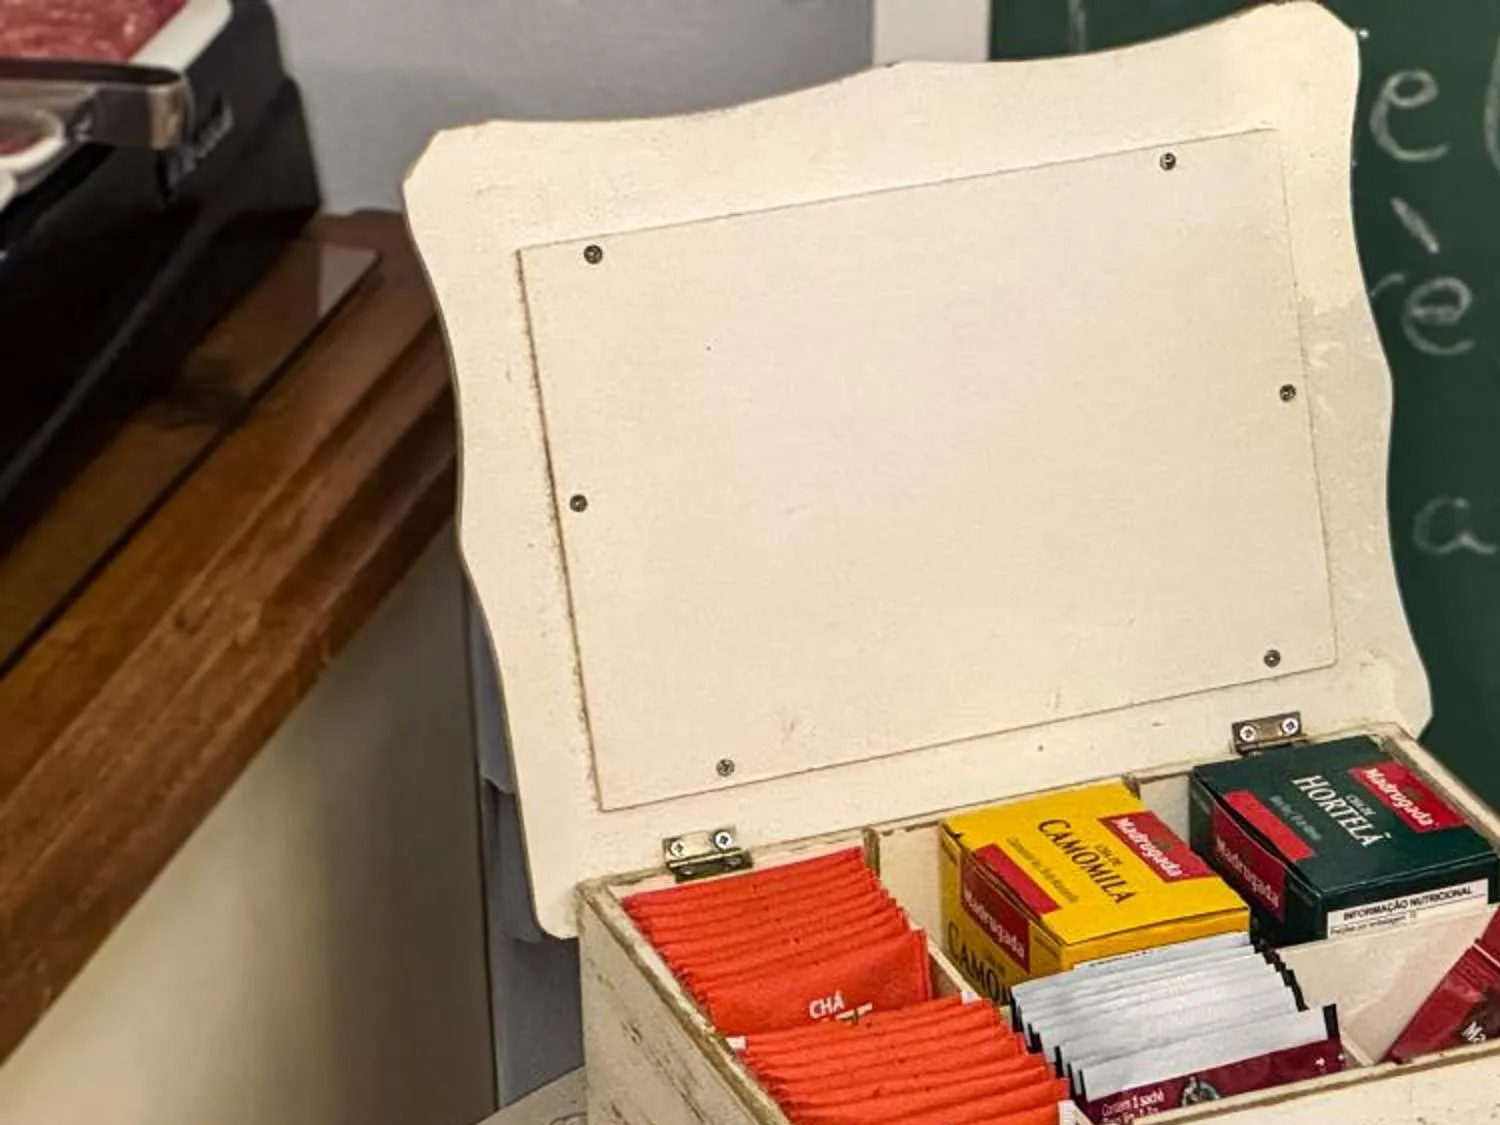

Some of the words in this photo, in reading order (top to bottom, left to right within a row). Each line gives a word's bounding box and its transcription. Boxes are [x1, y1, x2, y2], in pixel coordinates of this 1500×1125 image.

[1290, 774, 1393, 848] HORTELÃ
[1362, 766, 1435, 827] Madrugada
[1037, 818, 1138, 905] CAMOMILA
[1110, 816, 1184, 878] Madrugada
